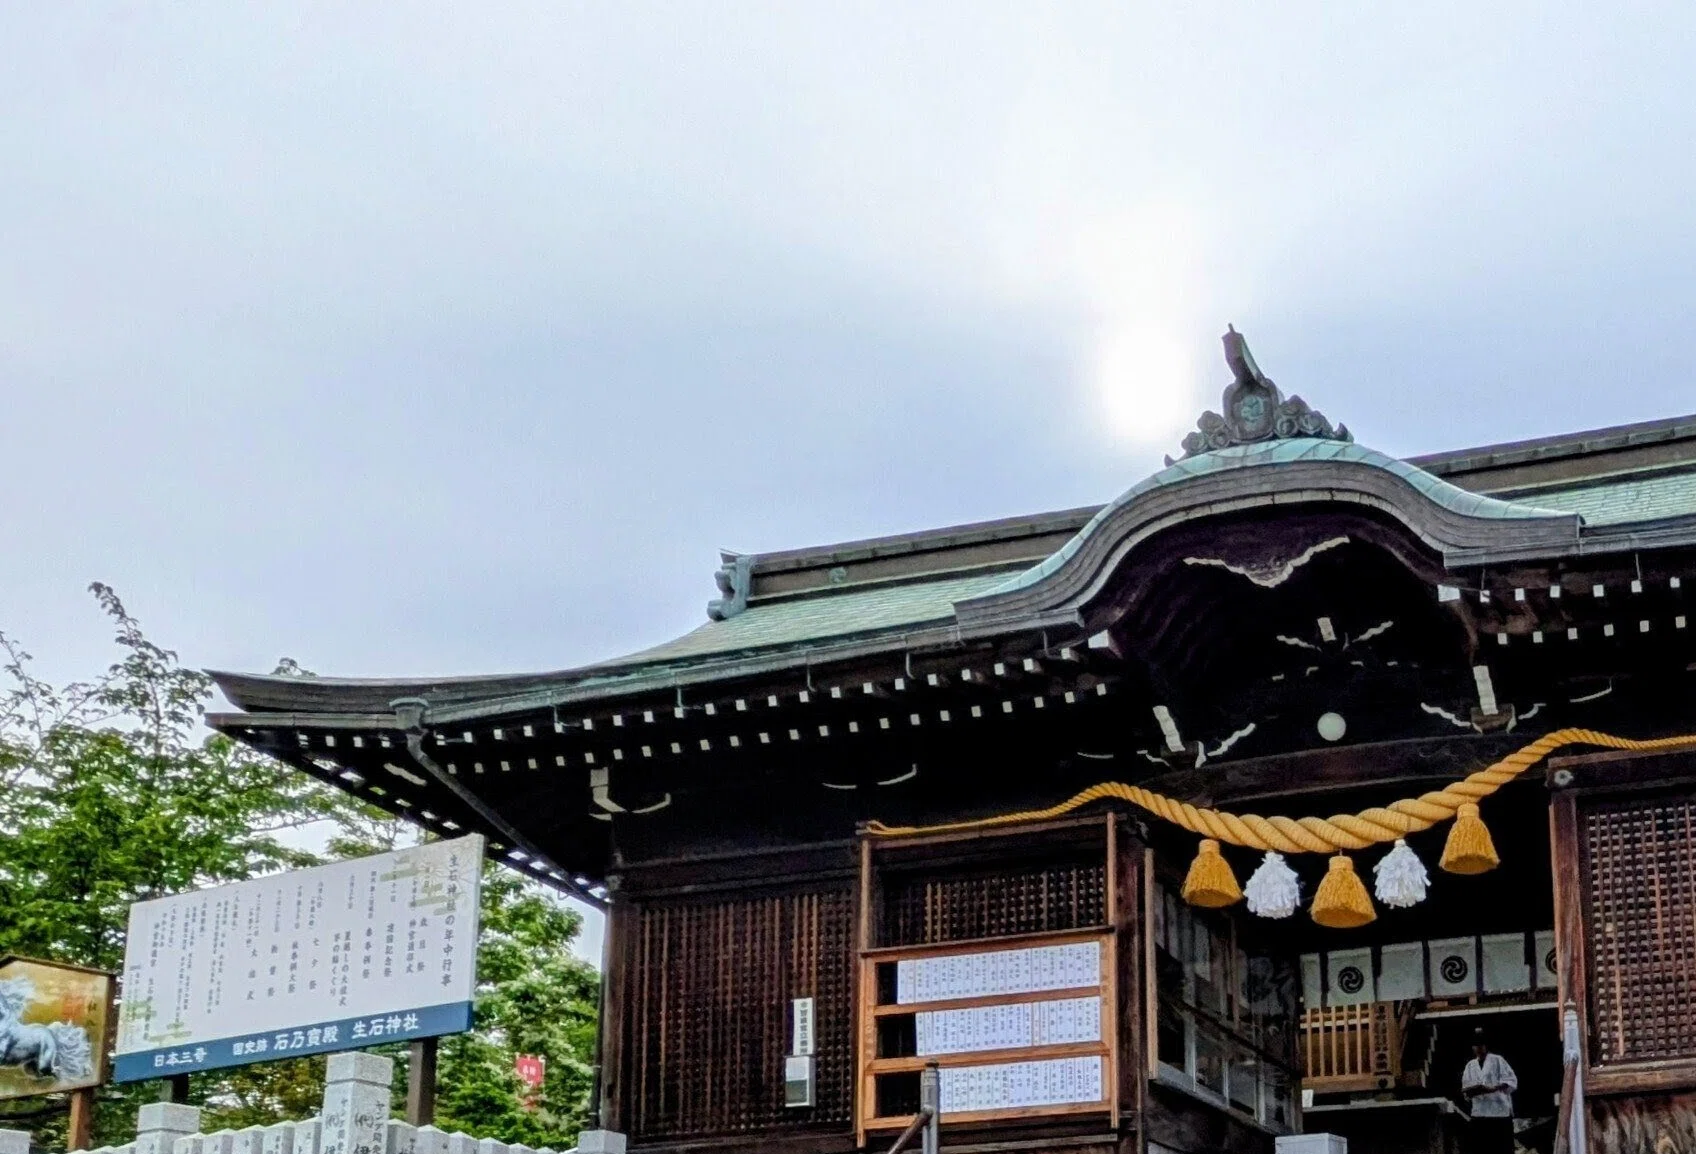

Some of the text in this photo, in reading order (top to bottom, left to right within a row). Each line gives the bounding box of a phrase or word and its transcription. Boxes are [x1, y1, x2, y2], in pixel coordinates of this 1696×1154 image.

[441, 854, 459, 987] 生石神社の年中行事
[352, 1013, 420, 1040] 生石神社
